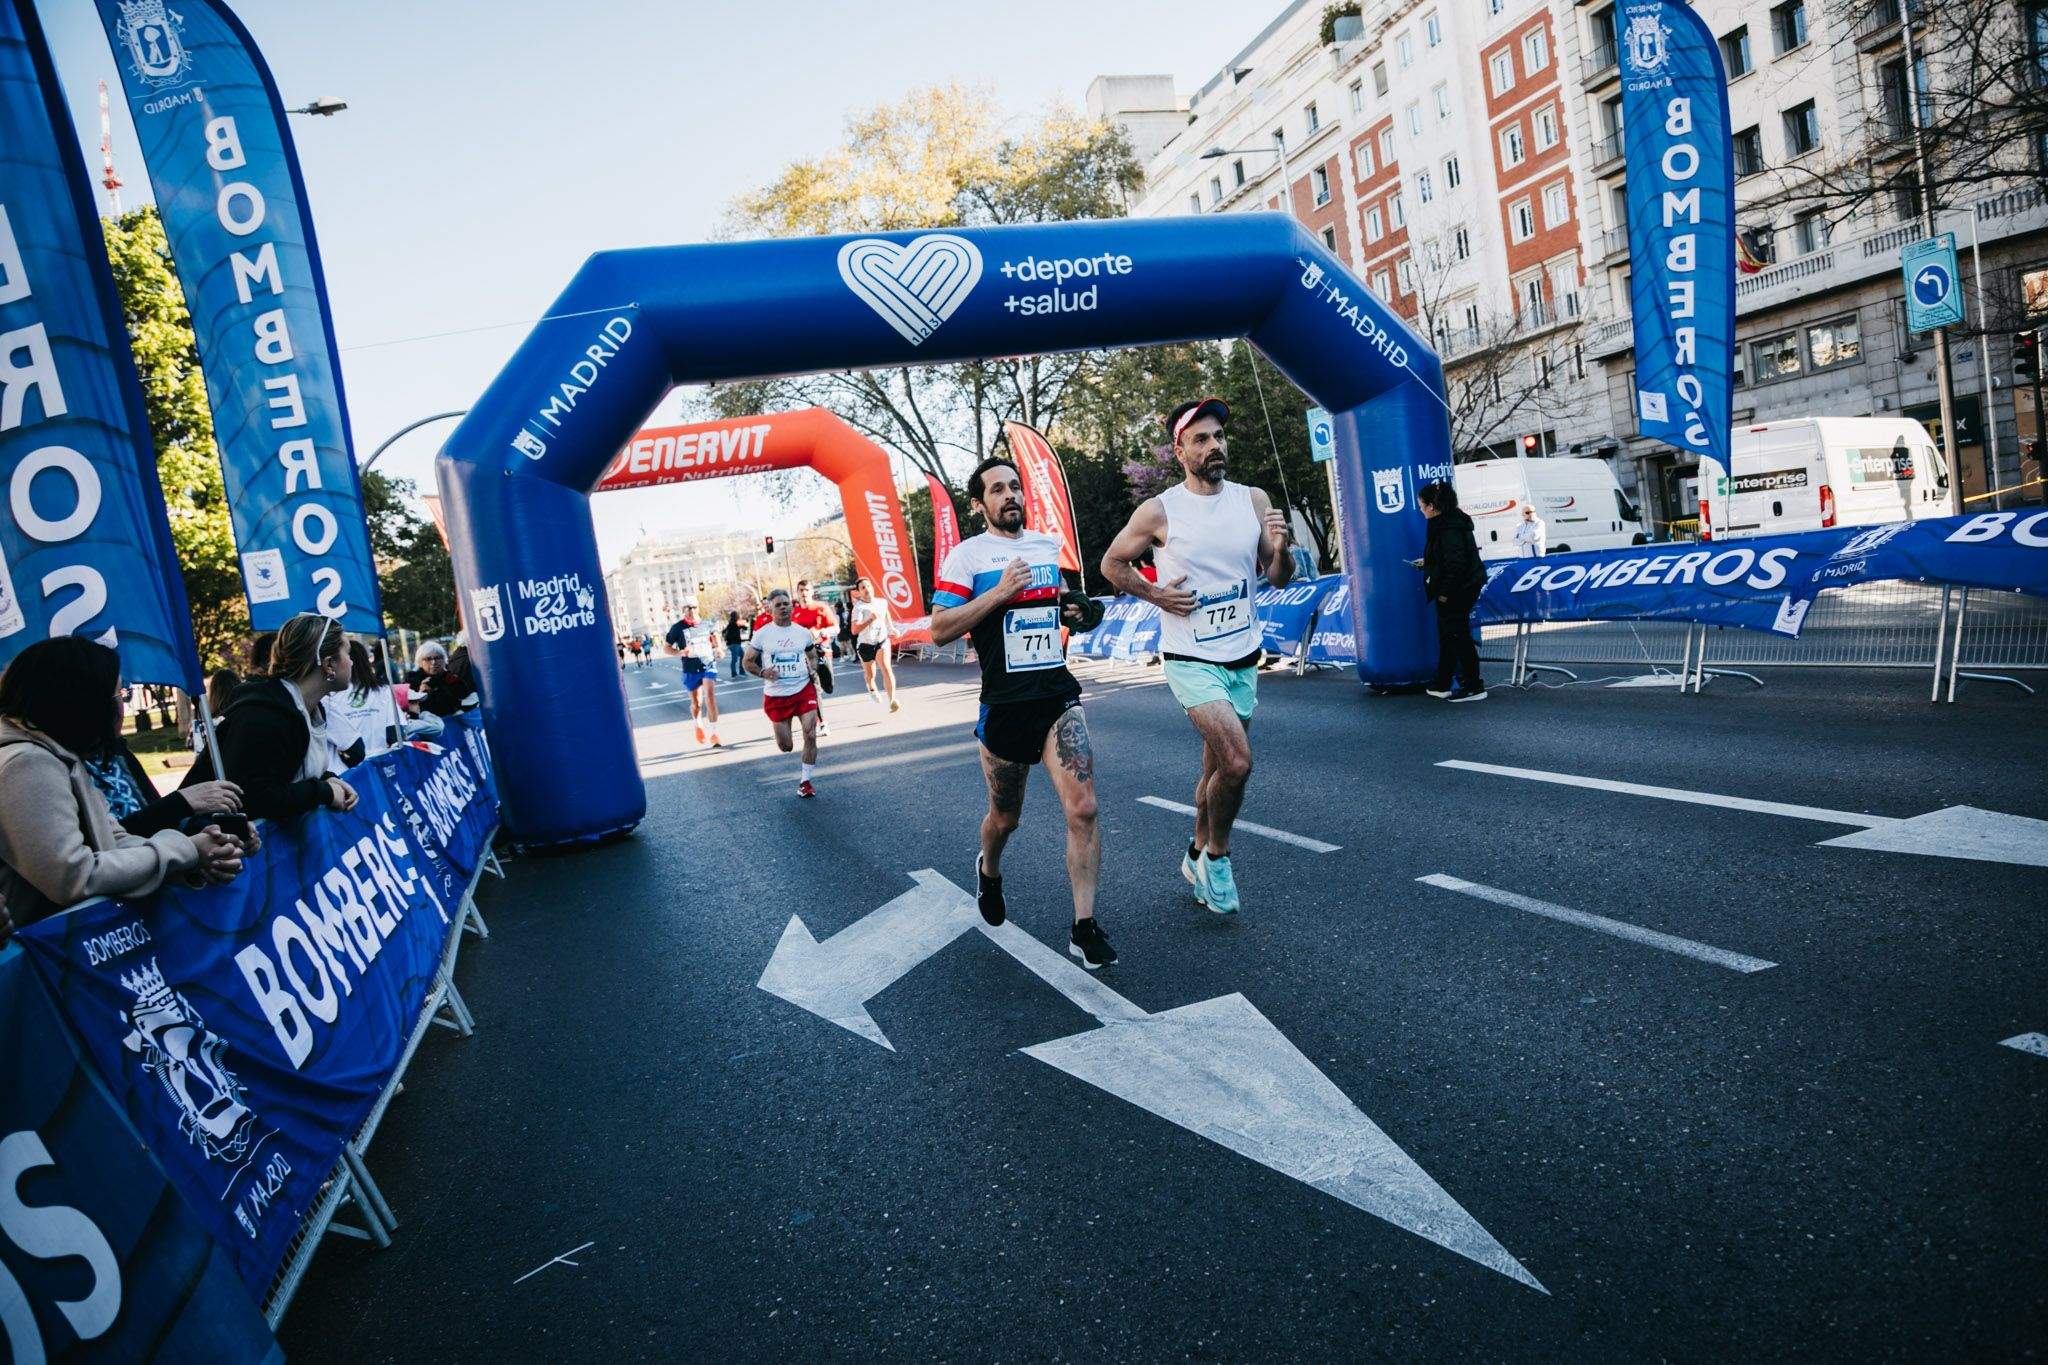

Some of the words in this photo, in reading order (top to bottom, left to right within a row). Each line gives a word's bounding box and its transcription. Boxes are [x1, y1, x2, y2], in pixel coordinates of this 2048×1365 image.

[1000, 251, 1133, 285] +deporte
[1004, 284, 1098, 316] +salud
[1326, 288, 1409, 368] MADRID
[540, 316, 633, 427] MADRID
[629, 424, 772, 474] ENERVIT
[865, 489, 904, 573] ENERVIT
[518, 573, 580, 599] Madrid
[1511, 548, 1798, 594] BOMBEROS
[1824, 561, 1866, 578] MADRID
[534, 593, 568, 618] es
[1255, 586, 1317, 607] ADRID
[525, 609, 595, 635] Deporte
[1207, 605, 1236, 625] 772
[1023, 634, 1051, 651] 771
[82, 919, 152, 966] BOMBEROS
[234, 812, 418, 1070] BOMBER
